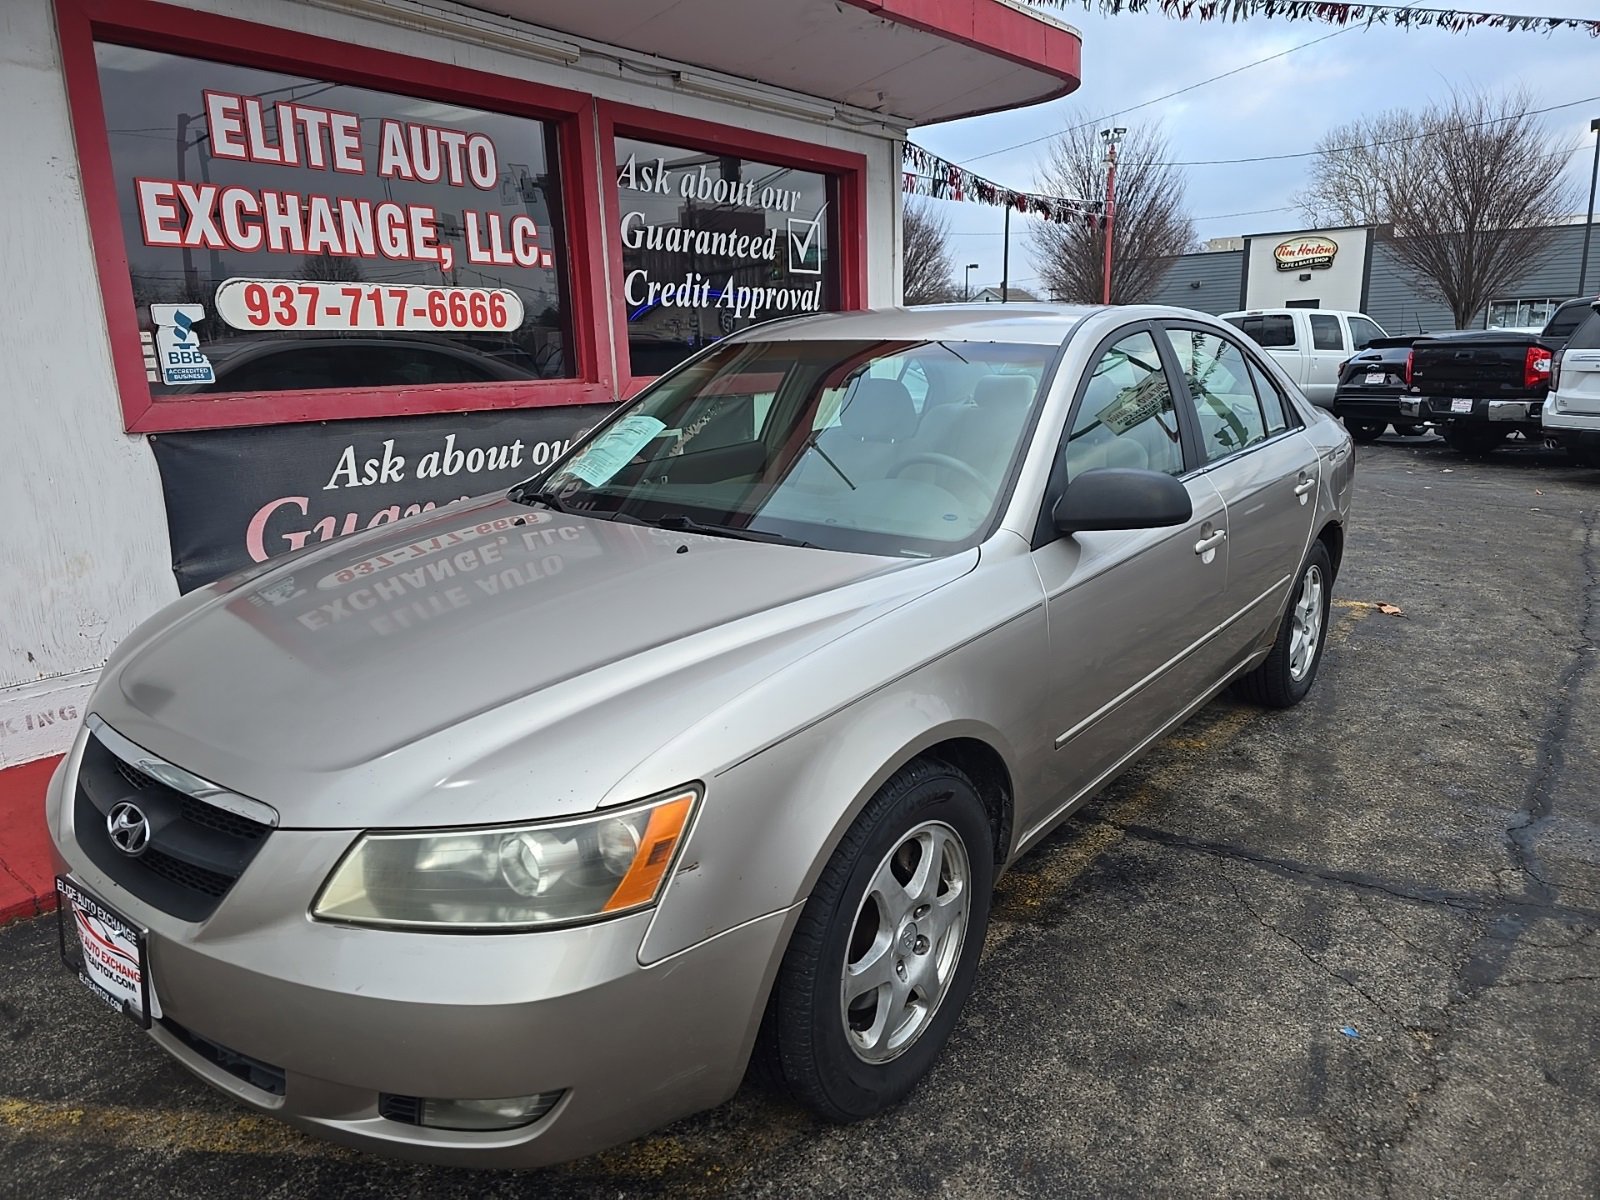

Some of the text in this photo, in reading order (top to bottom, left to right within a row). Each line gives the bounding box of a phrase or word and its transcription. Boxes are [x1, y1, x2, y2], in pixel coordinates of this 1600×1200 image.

[203, 90, 498, 190] ELITE AUTO
[617, 153, 802, 213] Ask about our
[135, 177, 553, 271] EXCHANGE, LLC.
[620, 211, 777, 261] Guaranteed
[1278, 245, 1297, 257] Tim
[244, 283, 508, 328] 937-717-6666
[624, 269, 822, 319] Credit Approval
[168, 351, 204, 365] BBB
[168, 367, 208, 375] ACCREDITED
[323, 439, 405, 490] Ask
[416, 434, 525, 479] about
[56, 878, 77, 901] ELITE
[77, 891, 97, 915] AUTO
[97, 907, 137, 945] EXCHANGE
[85, 936, 101, 958] AUTO
